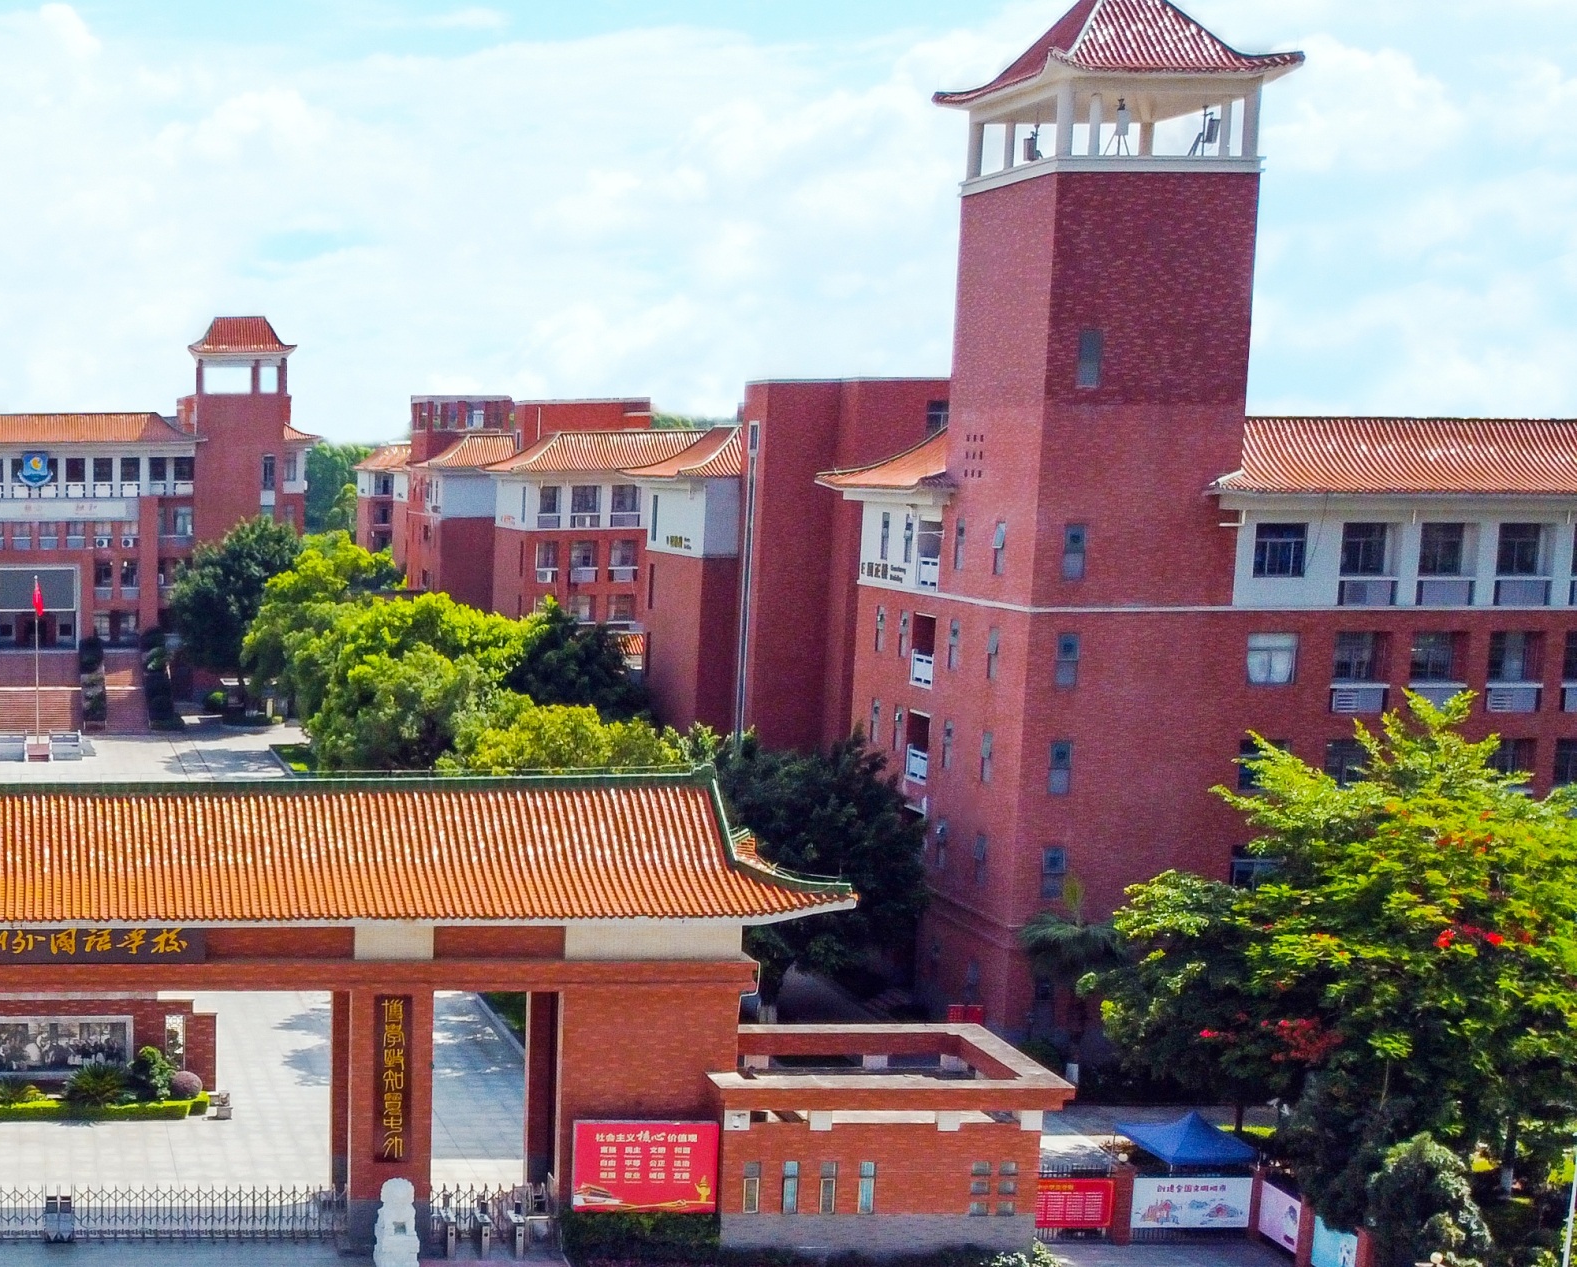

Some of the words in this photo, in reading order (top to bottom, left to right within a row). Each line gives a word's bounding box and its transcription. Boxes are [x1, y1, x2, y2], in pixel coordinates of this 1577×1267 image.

[595, 1130, 698, 1143] 社会主义核心价值观
